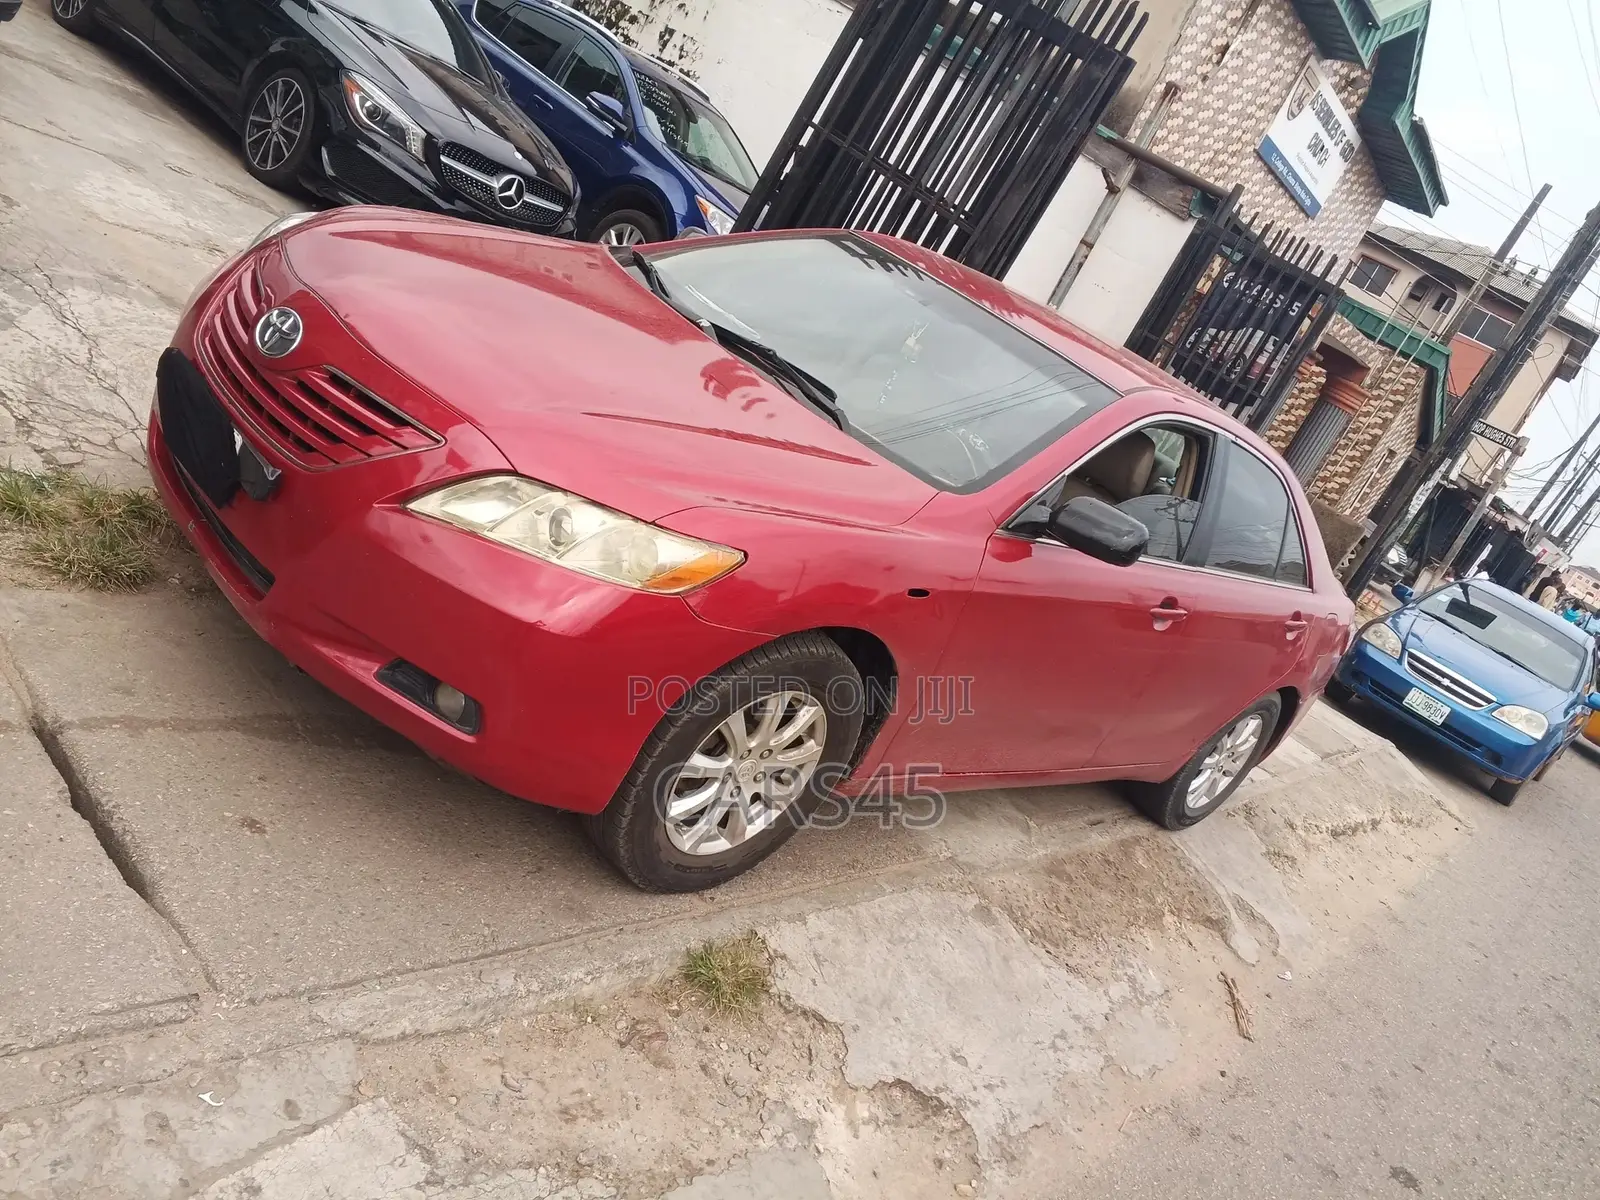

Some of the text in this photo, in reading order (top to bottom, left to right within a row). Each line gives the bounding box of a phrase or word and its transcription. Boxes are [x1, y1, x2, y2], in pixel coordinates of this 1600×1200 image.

[1308, 90, 1356, 163] ASSEMBLIES OF GOD
[1307, 132, 1330, 168] CHURCH
[1472, 420, 1517, 449] HOP HUGHES STR
